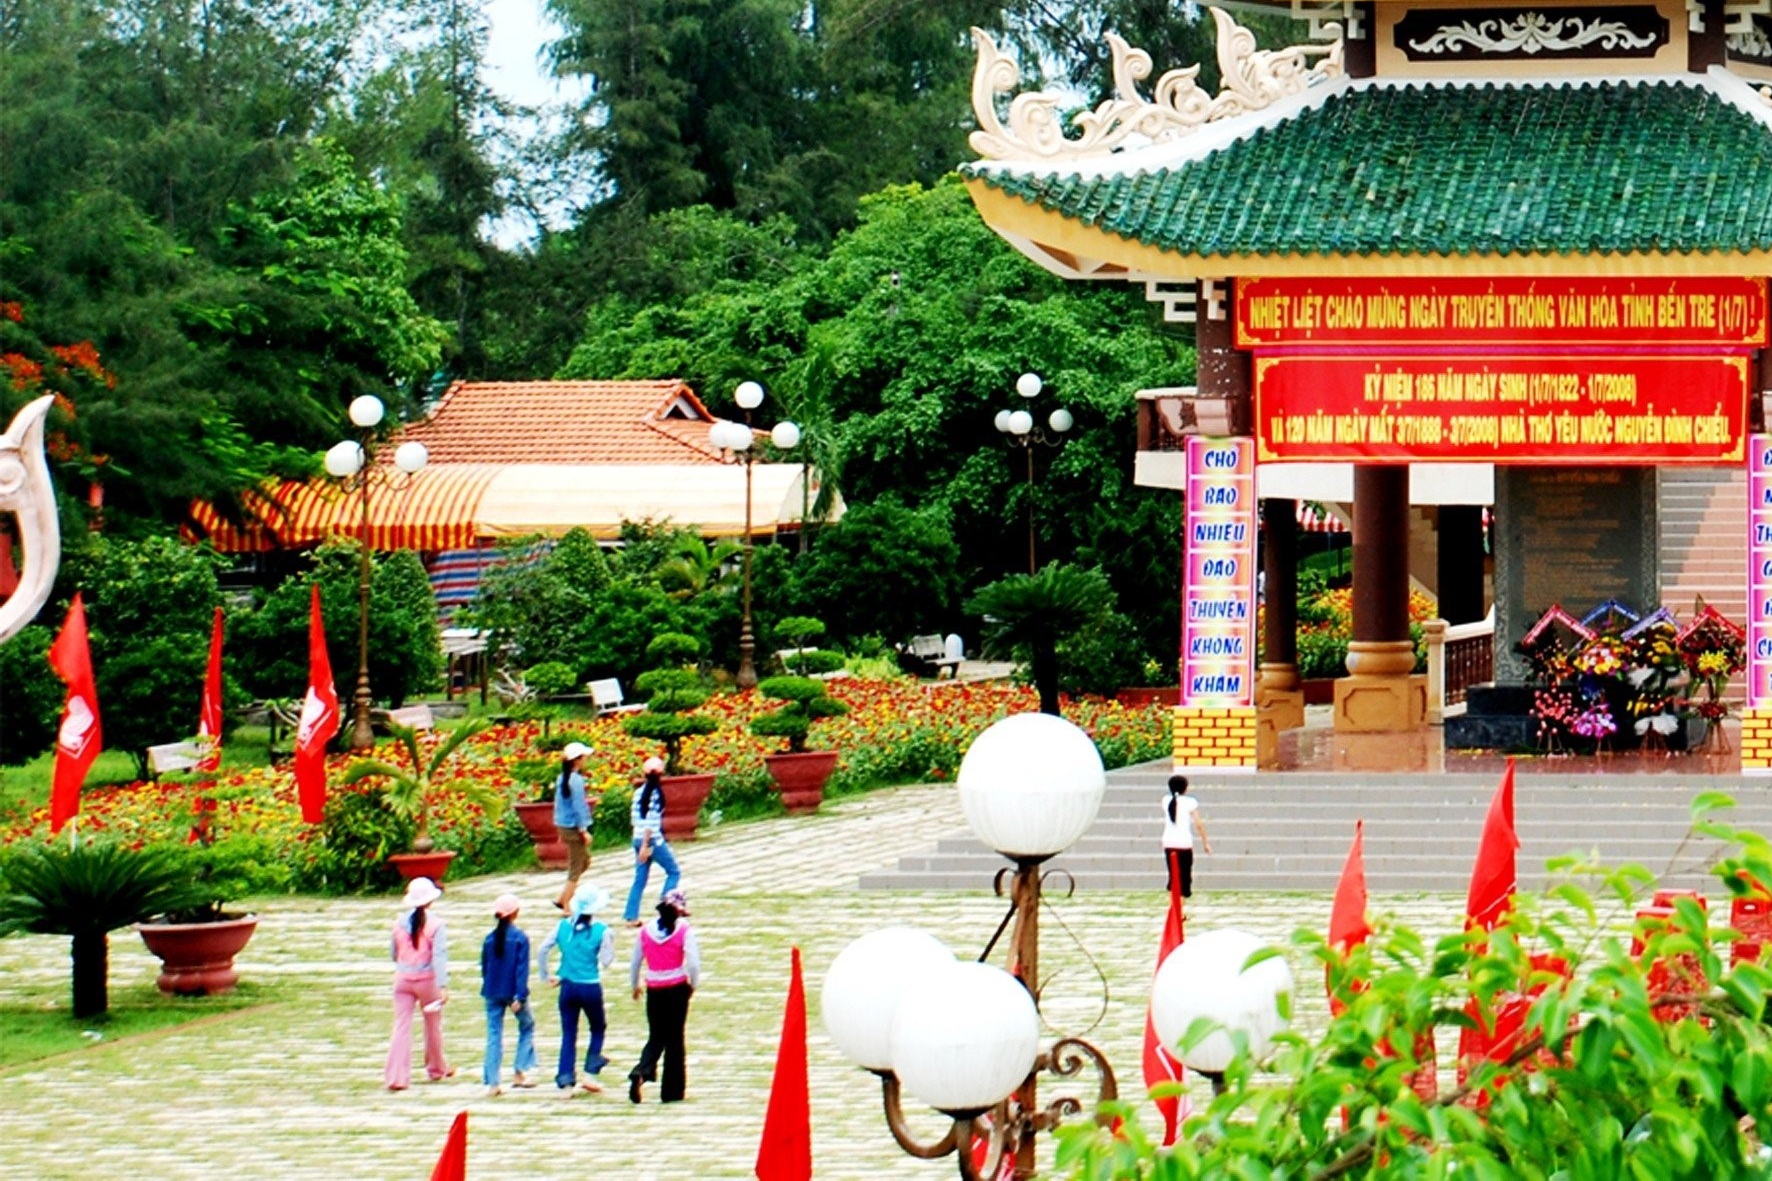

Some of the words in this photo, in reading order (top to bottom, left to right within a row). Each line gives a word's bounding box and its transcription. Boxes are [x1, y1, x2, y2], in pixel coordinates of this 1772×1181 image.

[1250, 288, 1290, 338] NHIỆT
[1293, 288, 1323, 338] LIỆT
[1326, 286, 1364, 329] CHÀO
[1366, 286, 1406, 329] MỪNG
[1409, 286, 1448, 329] NGÀY
[1451, 281, 1505, 328] TRUYỀN
[1508, 281, 1555, 328] THỐNG
[1559, 288, 1586, 327] VĂN
[1590, 286, 1618, 327] HÓA
[1622, 282, 1654, 327] TỈNH
[1657, 281, 1685, 327] BẾN
[1689, 295, 1716, 327] TRE
[1437, 367, 1463, 401] NĂM
[1465, 365, 1497, 401] NGÀY
[1499, 373, 1528, 401] SINH
[1307, 409, 1333, 444] NĂM
[1335, 407, 1368, 444] NGÀY
[1501, 408, 1526, 444] NHÀ
[1555, 409, 1579, 444] YÊU
[1205, 487, 1237, 505] BAO
